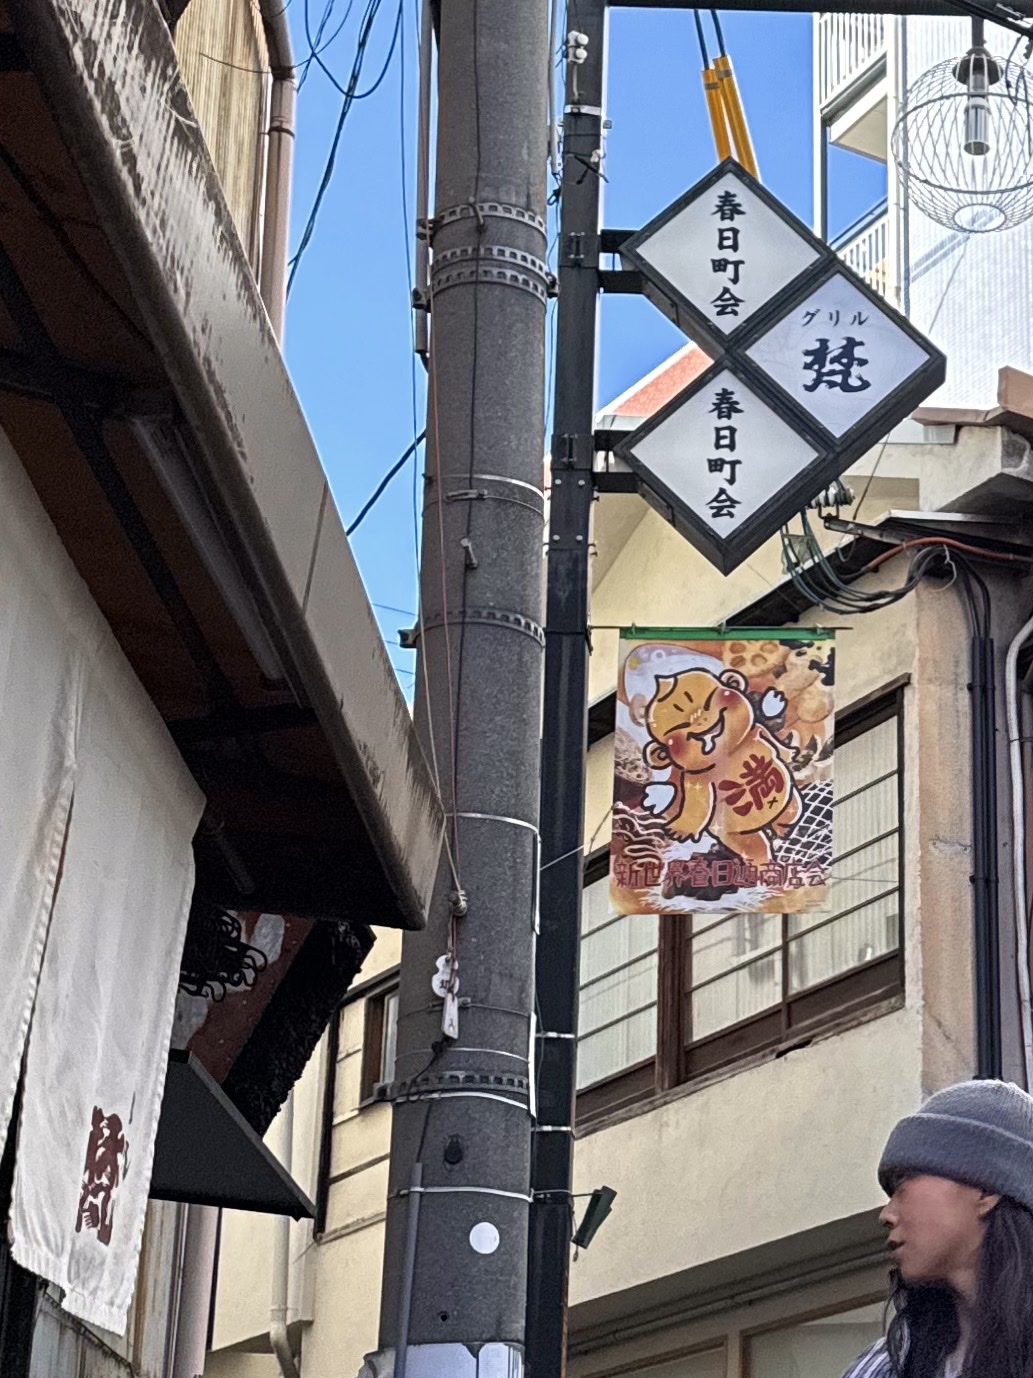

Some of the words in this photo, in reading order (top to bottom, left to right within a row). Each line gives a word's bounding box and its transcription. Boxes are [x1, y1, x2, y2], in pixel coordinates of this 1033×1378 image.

[710, 190, 746, 317] 春日町会
[801, 308, 870, 328] グリル
[706, 387, 744, 519] 春日町会
